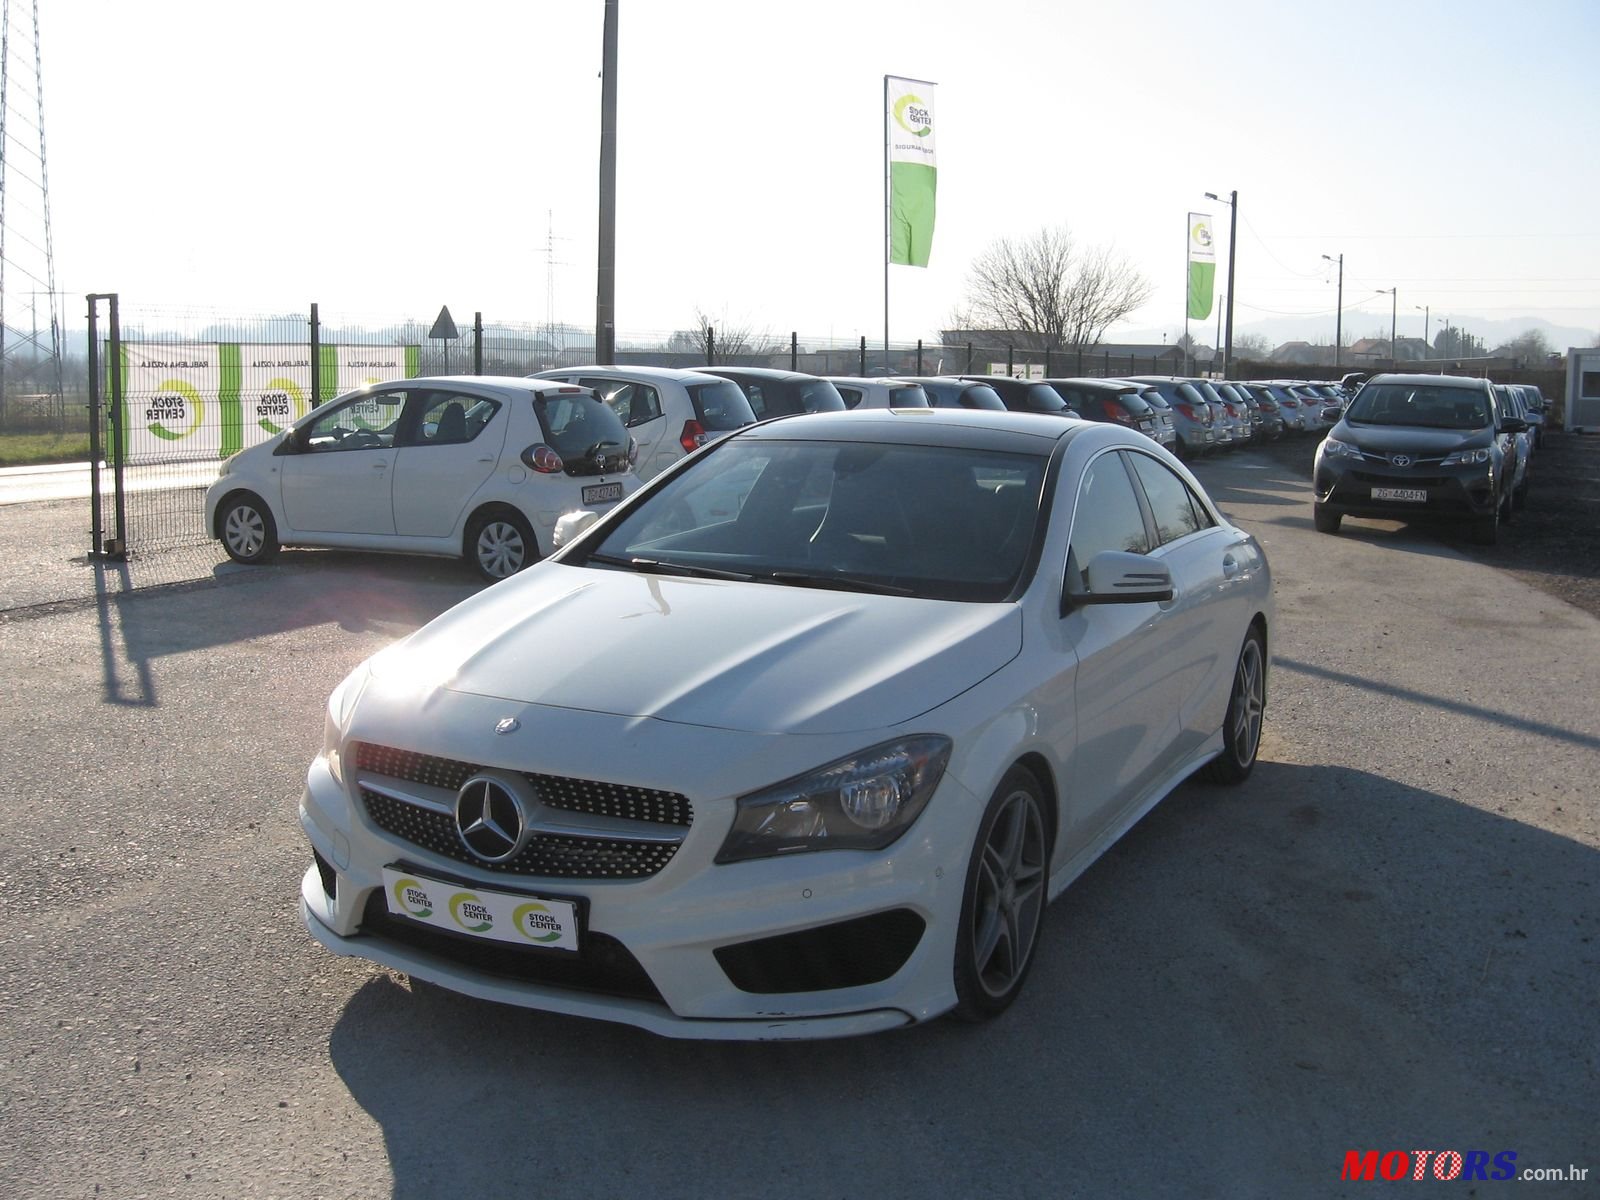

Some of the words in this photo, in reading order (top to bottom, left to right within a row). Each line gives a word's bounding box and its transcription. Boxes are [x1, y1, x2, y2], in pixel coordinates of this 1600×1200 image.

[407, 889, 427, 899] STOCK
[408, 896, 432, 908] CENTER
[463, 903, 487, 914] STOCK
[464, 911, 493, 922] CENTER
[529, 913, 556, 923] STOCK
[531, 921, 561, 931] CENTER
